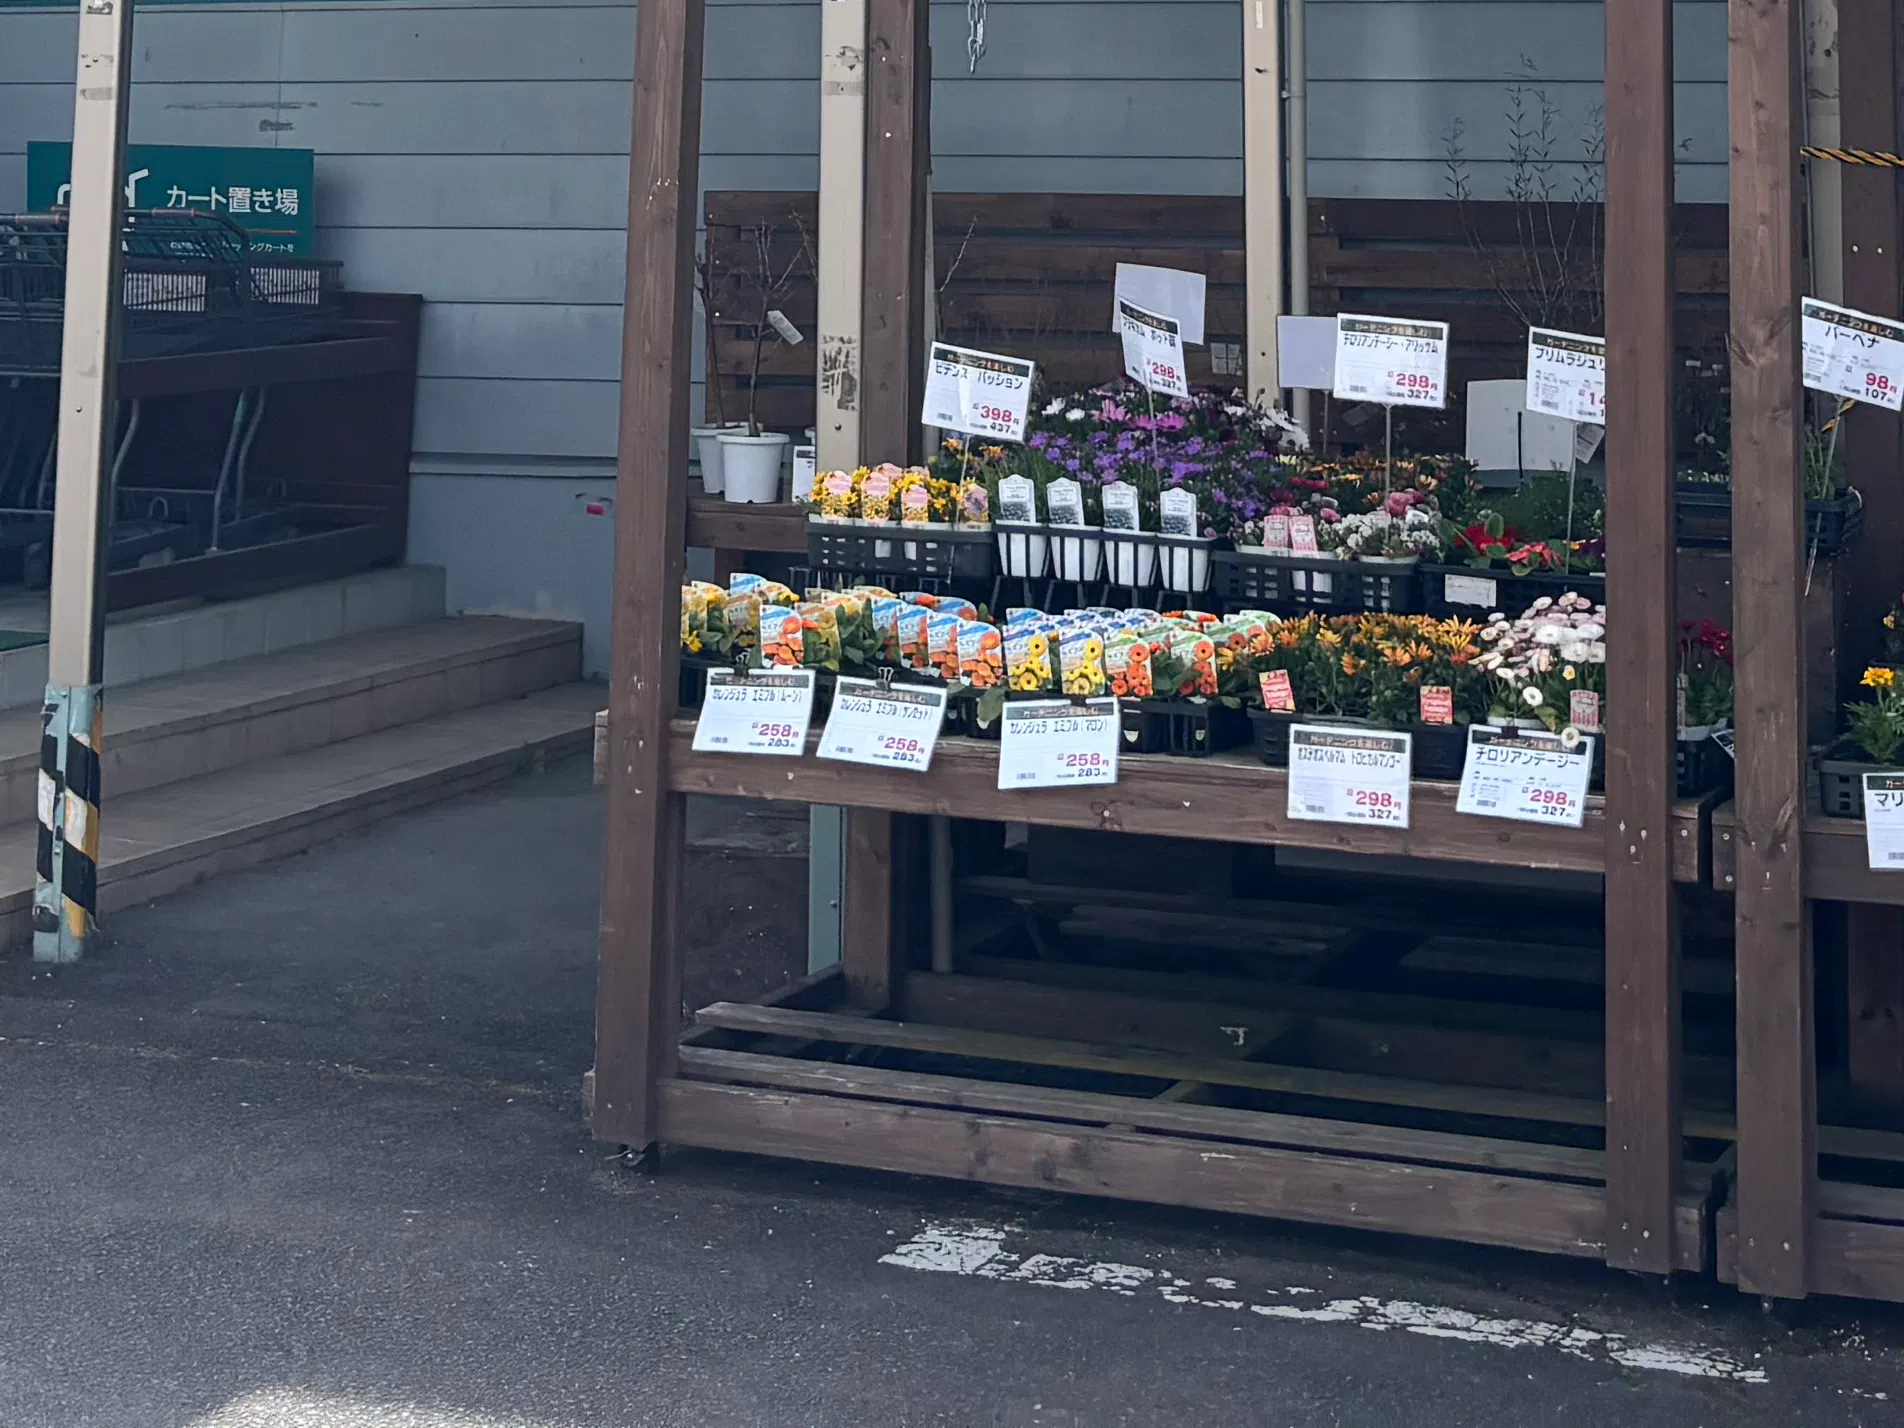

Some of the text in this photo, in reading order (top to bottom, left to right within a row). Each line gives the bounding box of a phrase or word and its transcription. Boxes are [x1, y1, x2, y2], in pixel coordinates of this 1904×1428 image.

[167, 185, 299, 215] カート置き場
[1825, 327, 1879, 348] バーベナ
[1407, 390, 1429, 400] 327
[1476, 747, 1579, 768] チロリアンデージー
[1369, 809, 1392, 819] 327
[1541, 805, 1566, 816] 327
